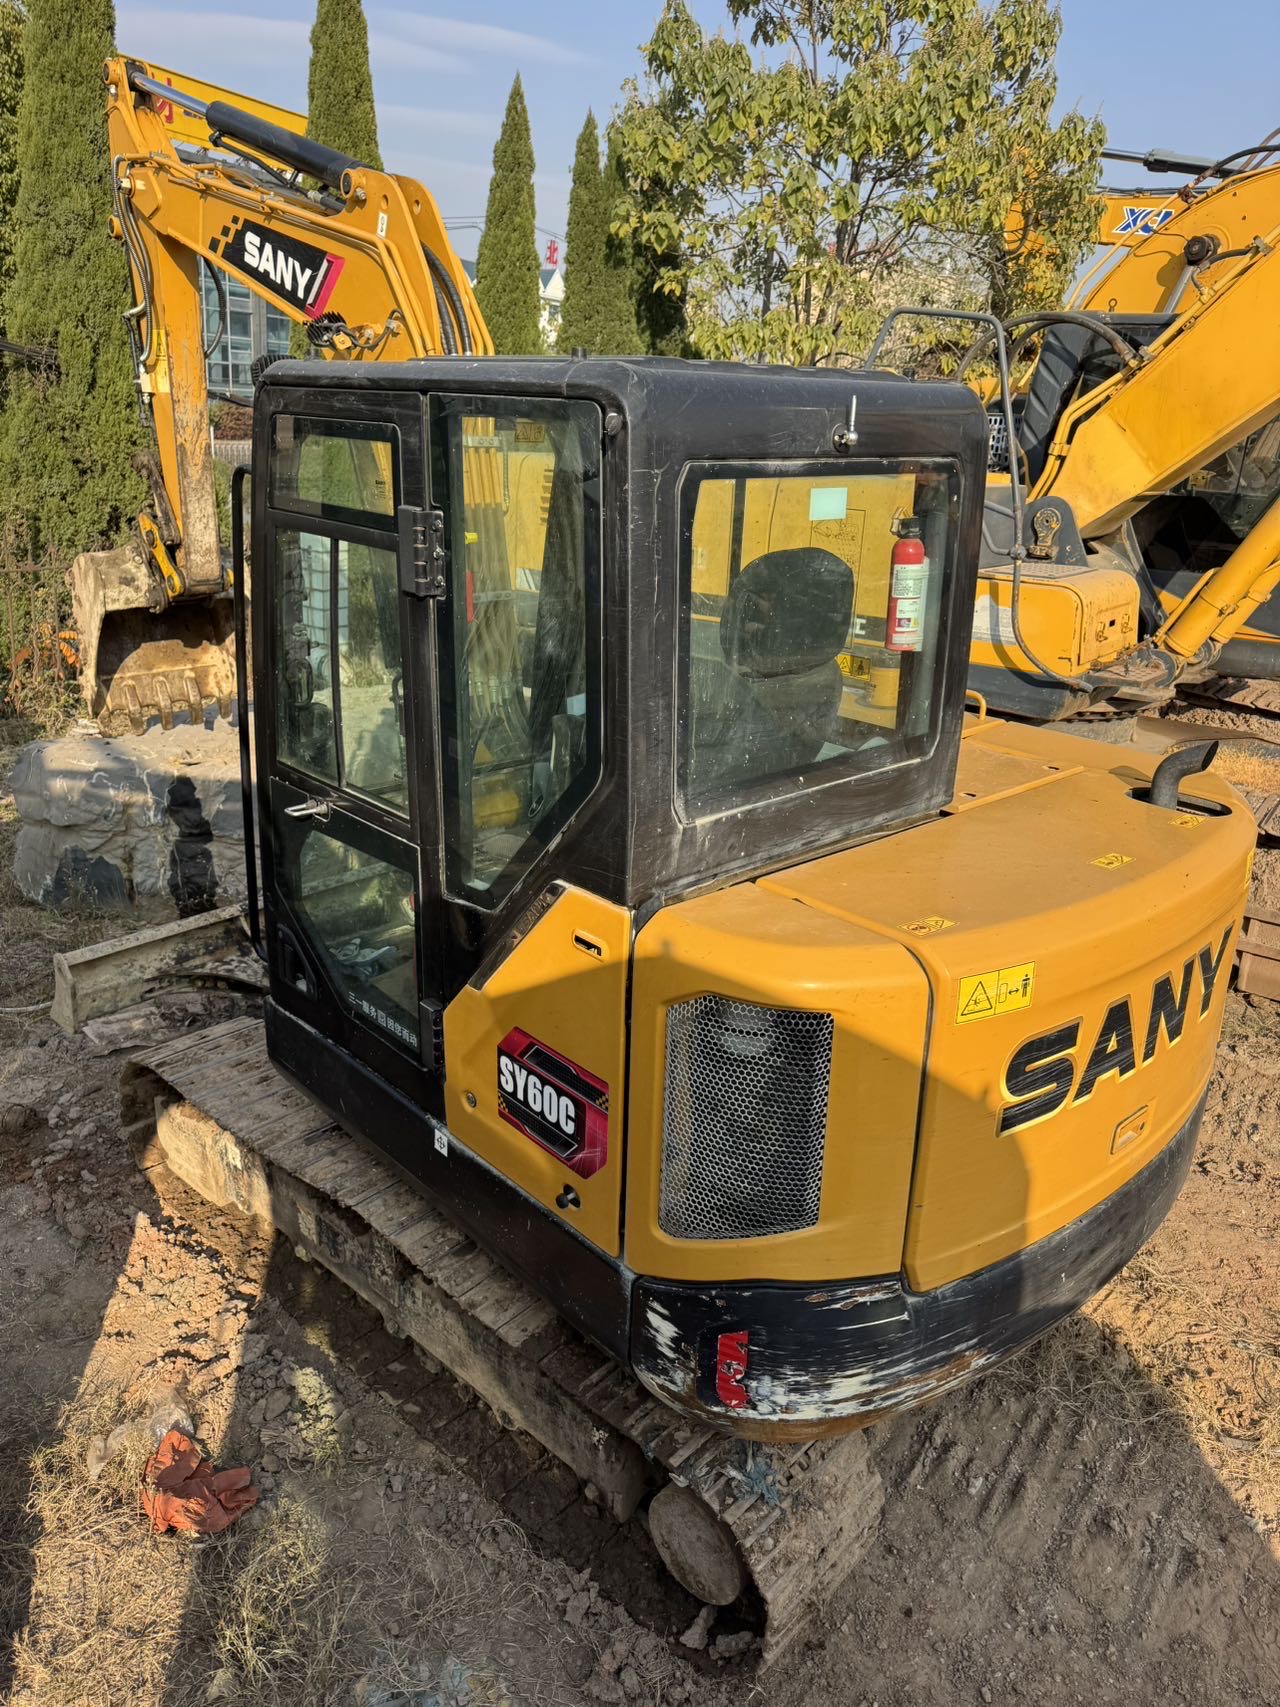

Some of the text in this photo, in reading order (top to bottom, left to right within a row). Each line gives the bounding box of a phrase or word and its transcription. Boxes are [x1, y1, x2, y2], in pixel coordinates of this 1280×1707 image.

[244, 231, 313, 300] SANY
[996, 918, 1236, 1137] SANY
[500, 1055, 576, 1135] SY60C
